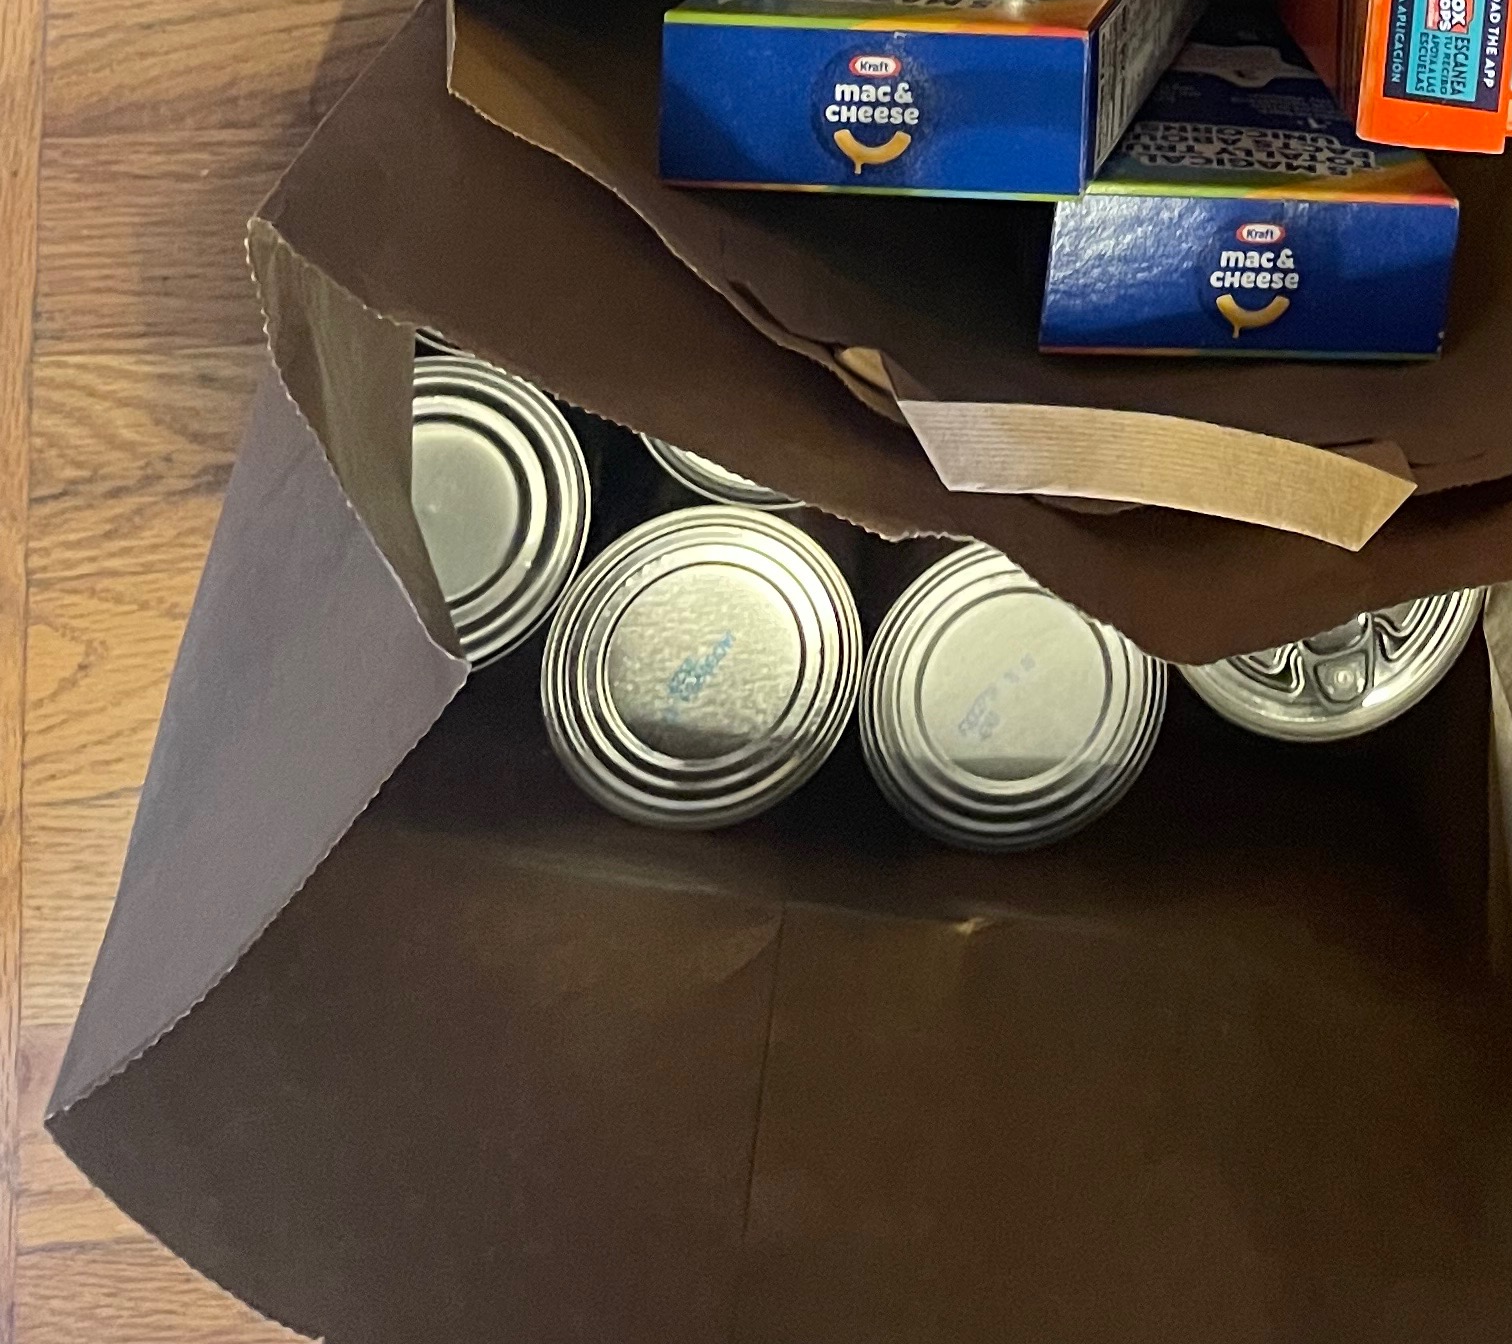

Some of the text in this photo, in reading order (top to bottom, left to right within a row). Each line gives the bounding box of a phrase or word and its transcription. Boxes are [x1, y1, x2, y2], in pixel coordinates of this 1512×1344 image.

[1391, 3, 1409, 83] APLICACIÓN
[1430, 34, 1440, 66] APOYA
[1444, 36, 1453, 55] TU
[1487, 27, 1500, 56] THE
[859, 59, 891, 74] Kraft
[1415, 32, 1429, 93] ESCUELAS
[1450, 36, 1470, 97] ESCANEA
[1483, 59, 1497, 88] APP
[834, 81, 913, 103] mac &
[1425, 75, 1436, 94] LAS
[1124, 142, 1203, 155] TRU
[1132, 131, 1241, 147] ABOU
[1138, 152, 1317, 174] MAGICAL
[1246, 227, 1275, 240] Kraft
[1220, 249, 1295, 269] mac &
